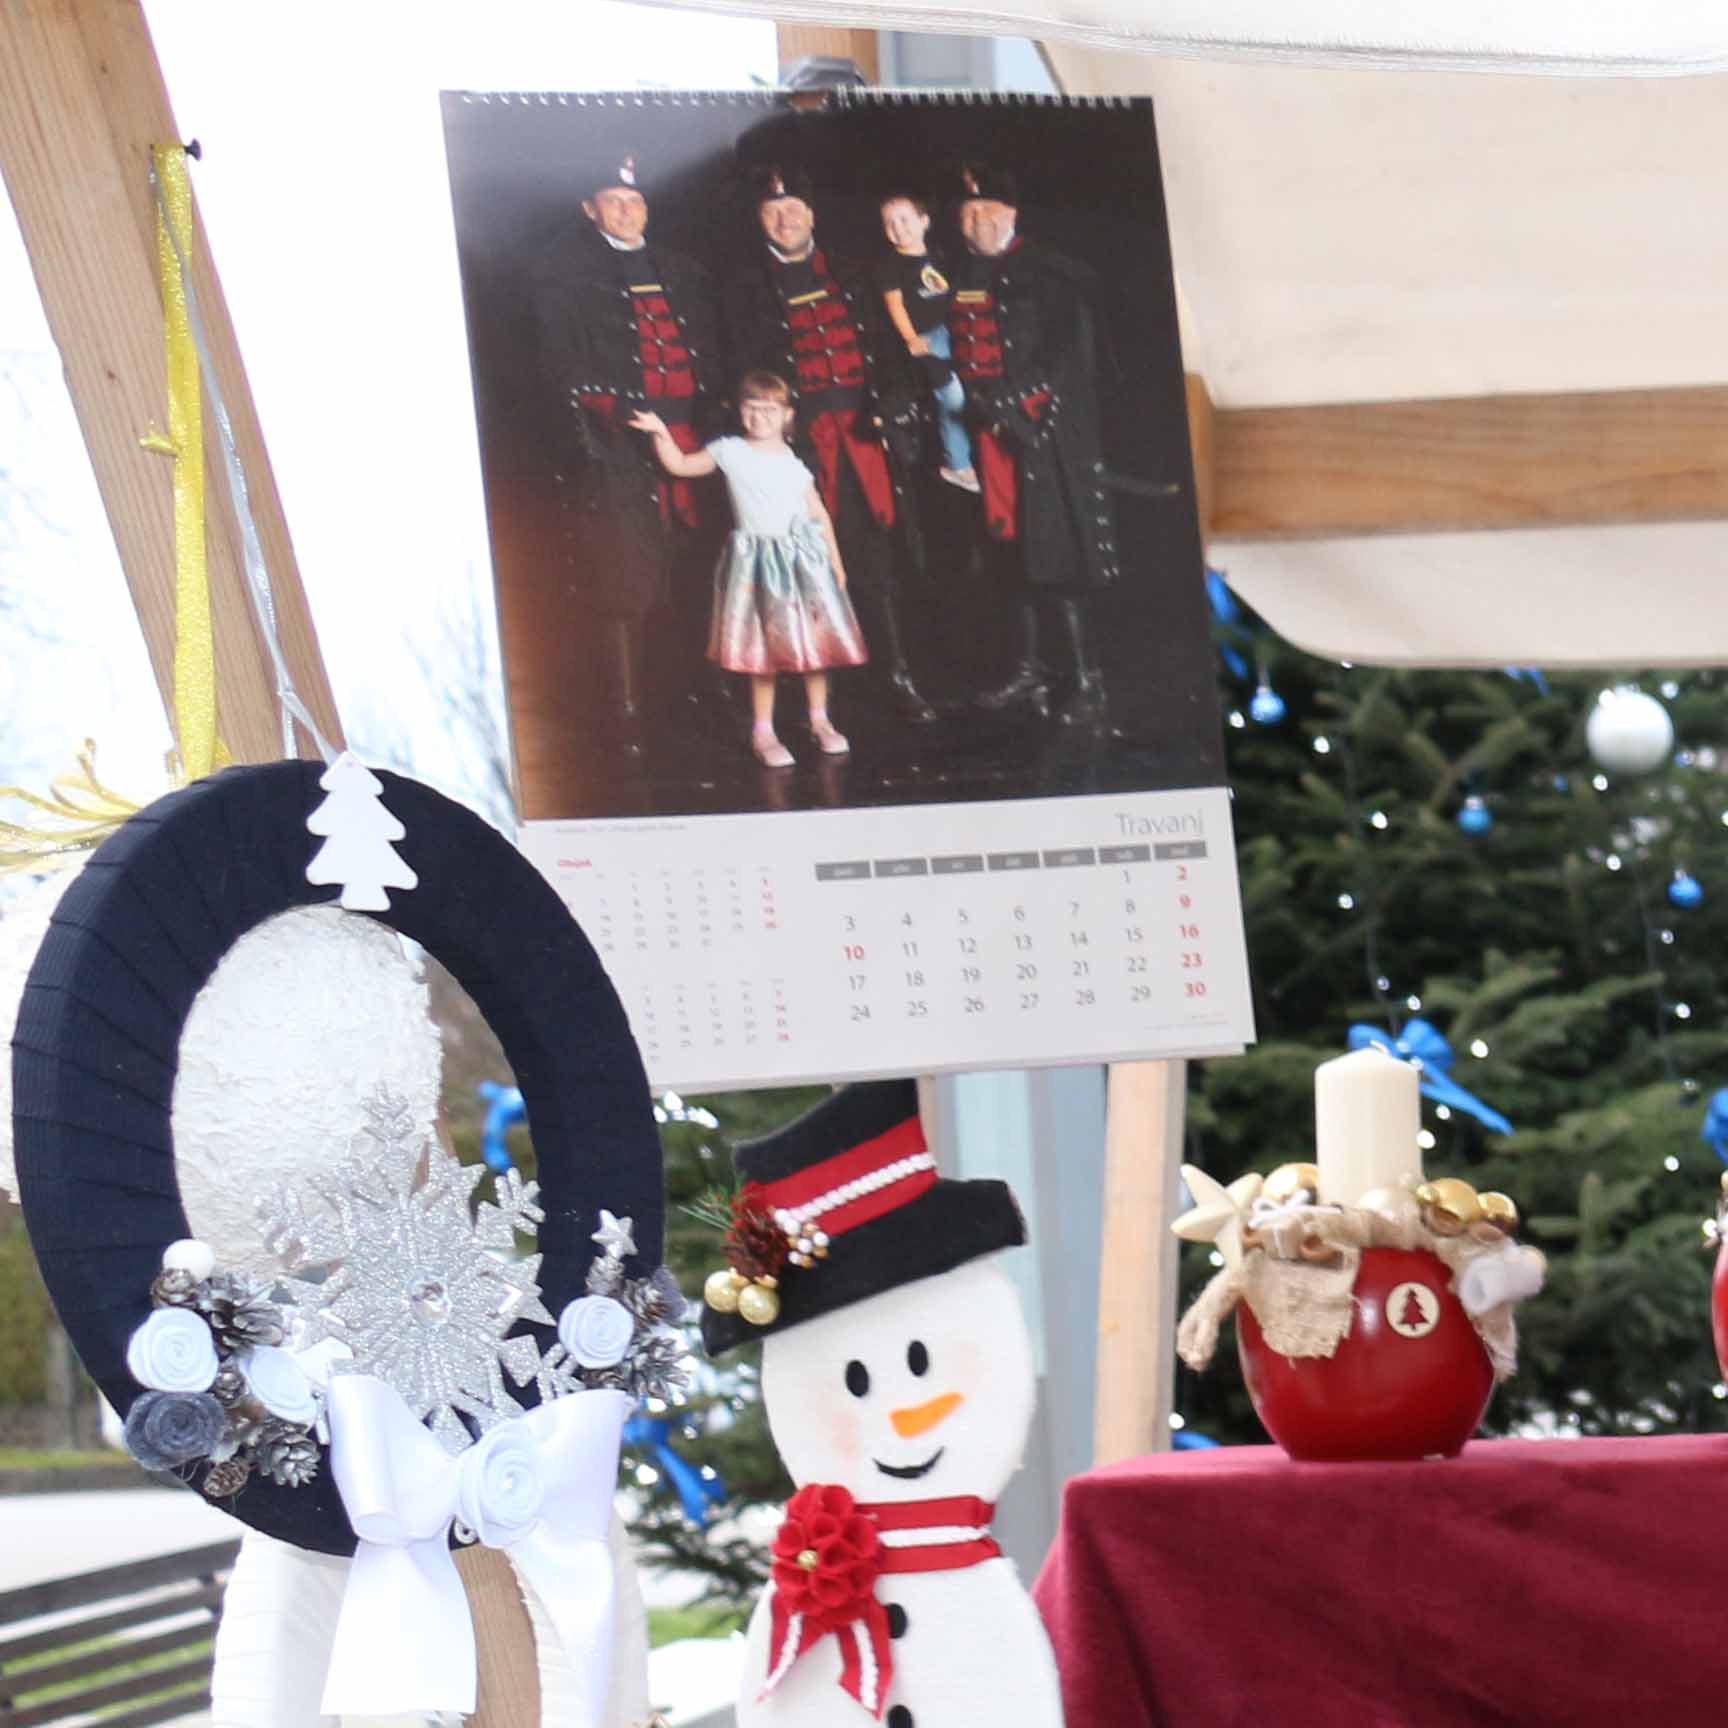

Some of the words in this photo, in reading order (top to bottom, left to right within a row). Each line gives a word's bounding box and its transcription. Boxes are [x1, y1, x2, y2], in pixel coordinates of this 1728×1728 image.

[1114, 810, 1205, 837] Travanj
[1176, 865, 1188, 881] 2
[844, 915, 857, 932] 3
[901, 911, 913, 927] 4
[958, 908, 969, 923] 5
[1013, 905, 1025, 921] 6
[1069, 901, 1080, 917] 7
[1124, 898, 1136, 915] 8
[1178, 894, 1192, 910] 9
[843, 944, 865, 961] 10
[902, 941, 919, 957] 11
[959, 937, 977, 954] 12
[1015, 934, 1033, 950] 13
[1070, 931, 1089, 946] 14
[1125, 927, 1144, 943] 15
[1179, 923, 1200, 940] 16
[848, 974, 867, 991] 17
[905, 969, 925, 987] 18
[961, 967, 981, 984] 19
[1015, 963, 1038, 981] 20
[1072, 960, 1089, 977] 21
[1127, 956, 1147, 973] 22
[1181, 951, 1204, 969] 23
[850, 1004, 872, 1022] 24
[907, 1000, 929, 1017] 25
[964, 997, 985, 1013] 26
[1020, 992, 1039, 1009] 27
[1074, 989, 1097, 1007] 28
[1130, 985, 1152, 1002] 29
[1184, 981, 1208, 998] 30
